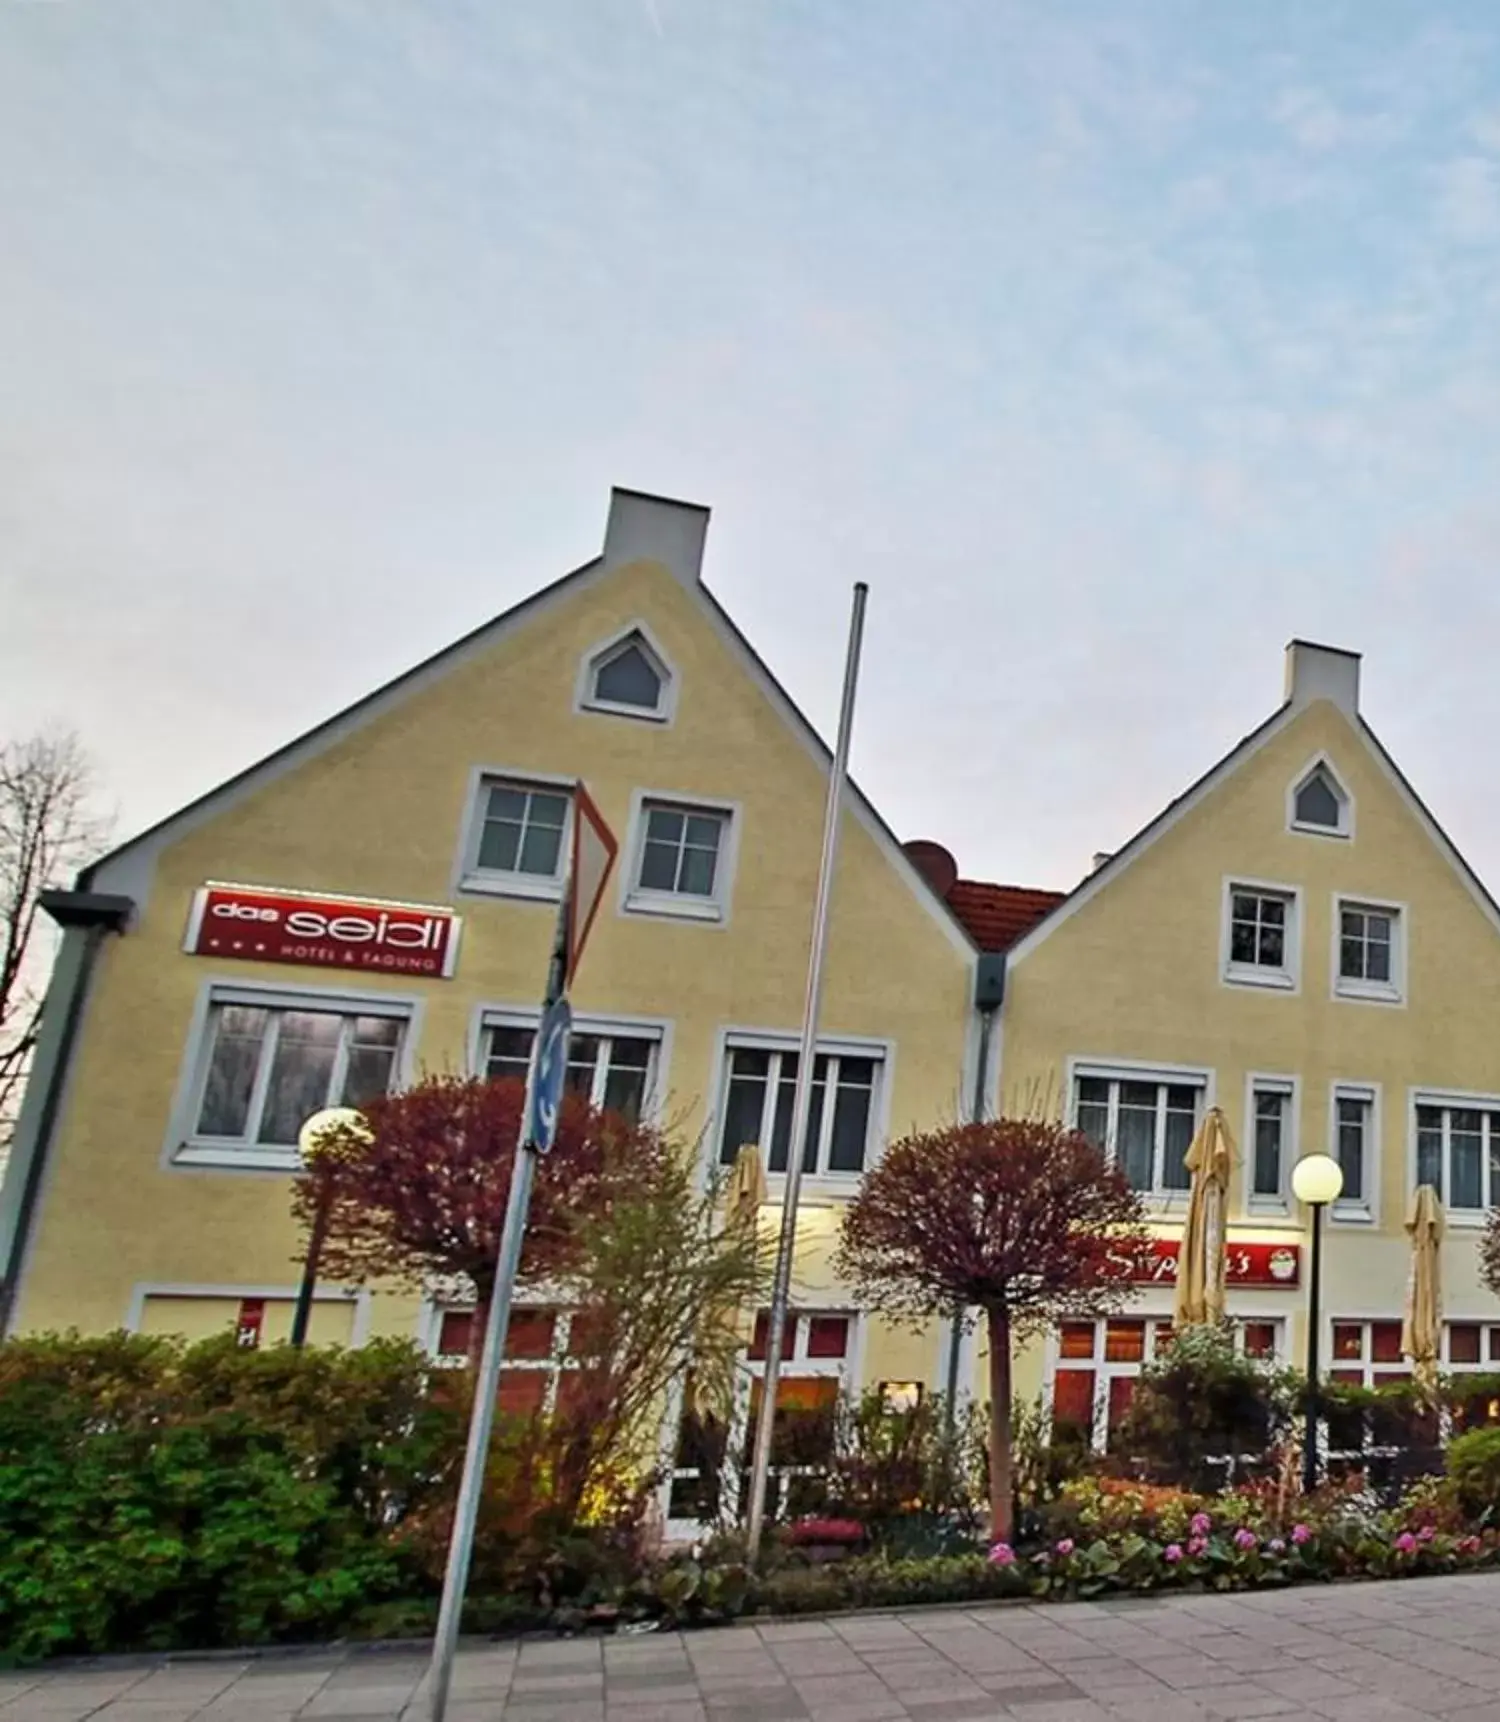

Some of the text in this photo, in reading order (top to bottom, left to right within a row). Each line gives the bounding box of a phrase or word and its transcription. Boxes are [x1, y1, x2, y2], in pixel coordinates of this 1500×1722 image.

[213, 902, 444, 949] das seidl
[280, 945, 335, 962] HOTEL
[361, 953, 436, 970] TAGUNG
